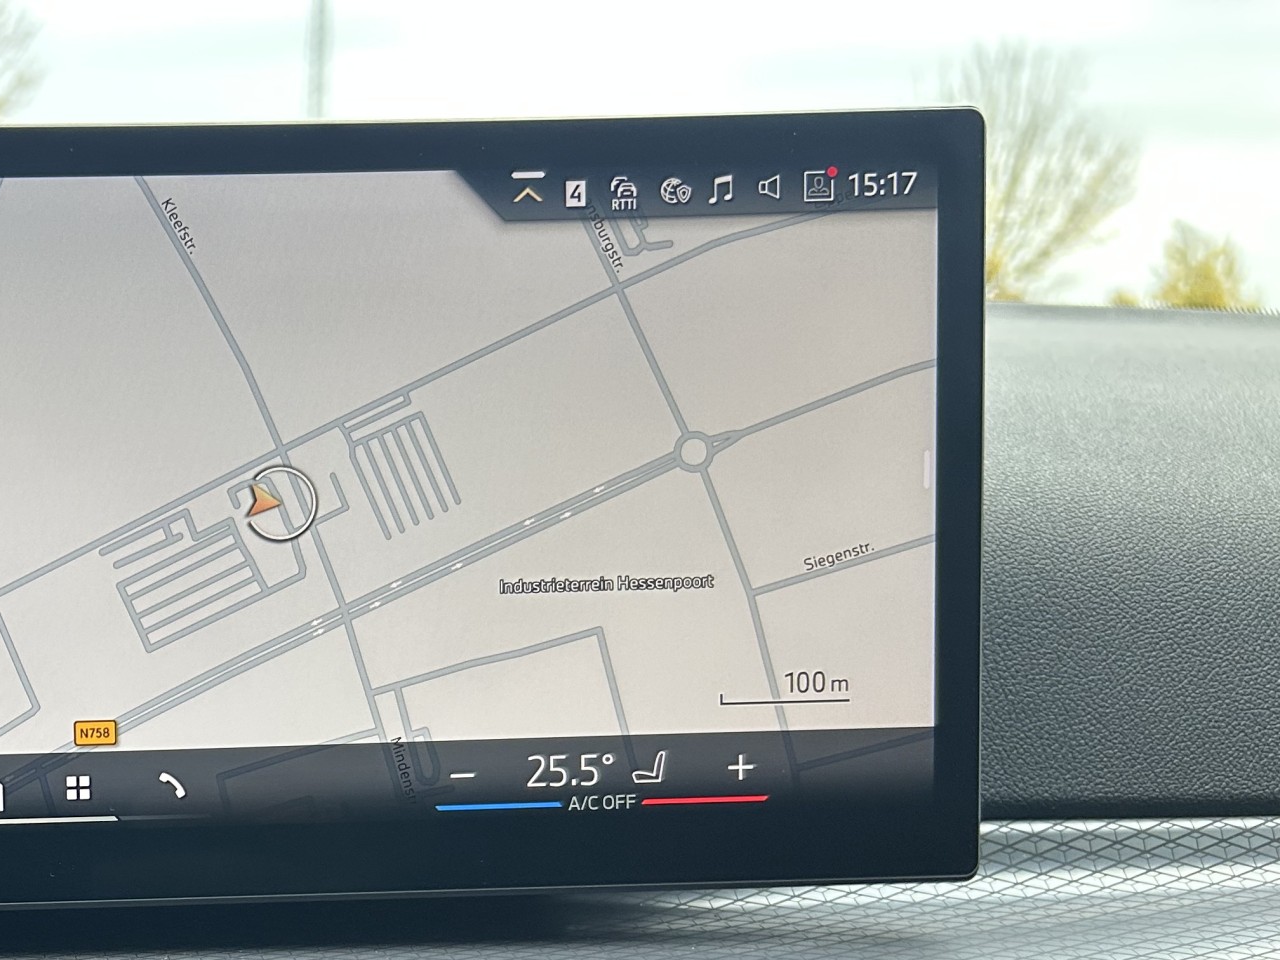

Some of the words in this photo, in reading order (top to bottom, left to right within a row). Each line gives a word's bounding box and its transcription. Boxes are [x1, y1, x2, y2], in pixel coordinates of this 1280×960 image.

[848, 171, 918, 197] 15:17
[611, 197, 638, 211] RTTI
[161, 197, 196, 255] Kleefstr.
[803, 542, 876, 572] Siegenstr.
[499, 576, 614, 594] Industrieterrein
[617, 574, 715, 592] Hessenpoort
[783, 671, 826, 694] 100
[830, 676, 850, 693] m
[80, 727, 110, 739] N758
[526, 753, 616, 788] 25.5°
[567, 795, 600, 811] A/C
[601, 794, 637, 810] OFF
